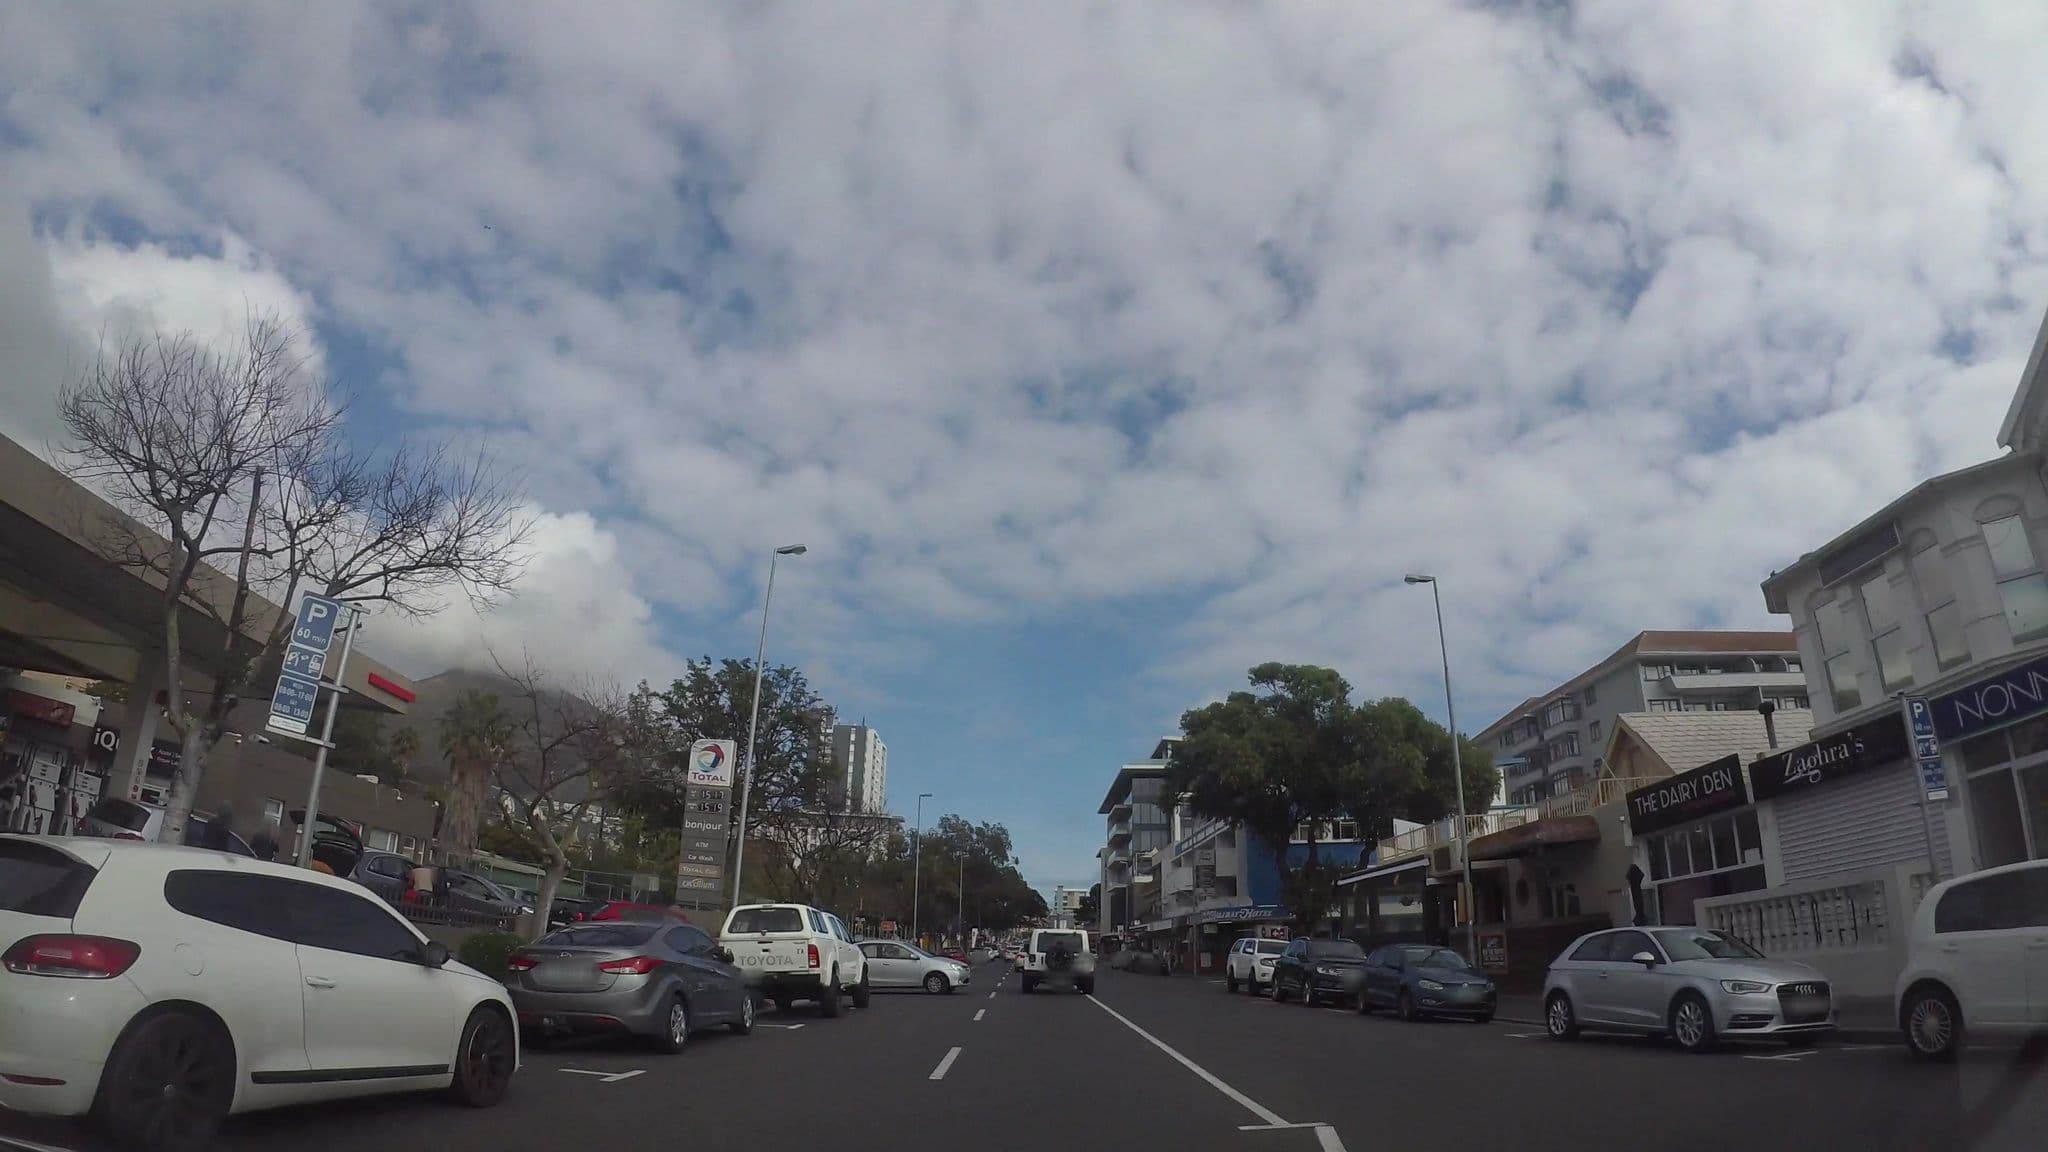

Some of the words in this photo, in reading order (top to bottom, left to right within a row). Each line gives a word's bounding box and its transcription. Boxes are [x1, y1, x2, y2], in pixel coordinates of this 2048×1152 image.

[307, 602, 328, 622] P
[297, 627, 311, 638] 60
[311, 636, 326, 644] min
[1913, 702, 1924, 718] P
[94, 727, 120, 751] iQ
[1781, 732, 1864, 784] Zaghra's
[691, 772, 726, 782] TOTAL
[1634, 792, 1659, 815] THE
[1660, 779, 1699, 808] DAIRY
[1702, 767, 1733, 795] DEN
[684, 819, 723, 832] bonjour
[739, 955, 794, 966] TOYOTA
